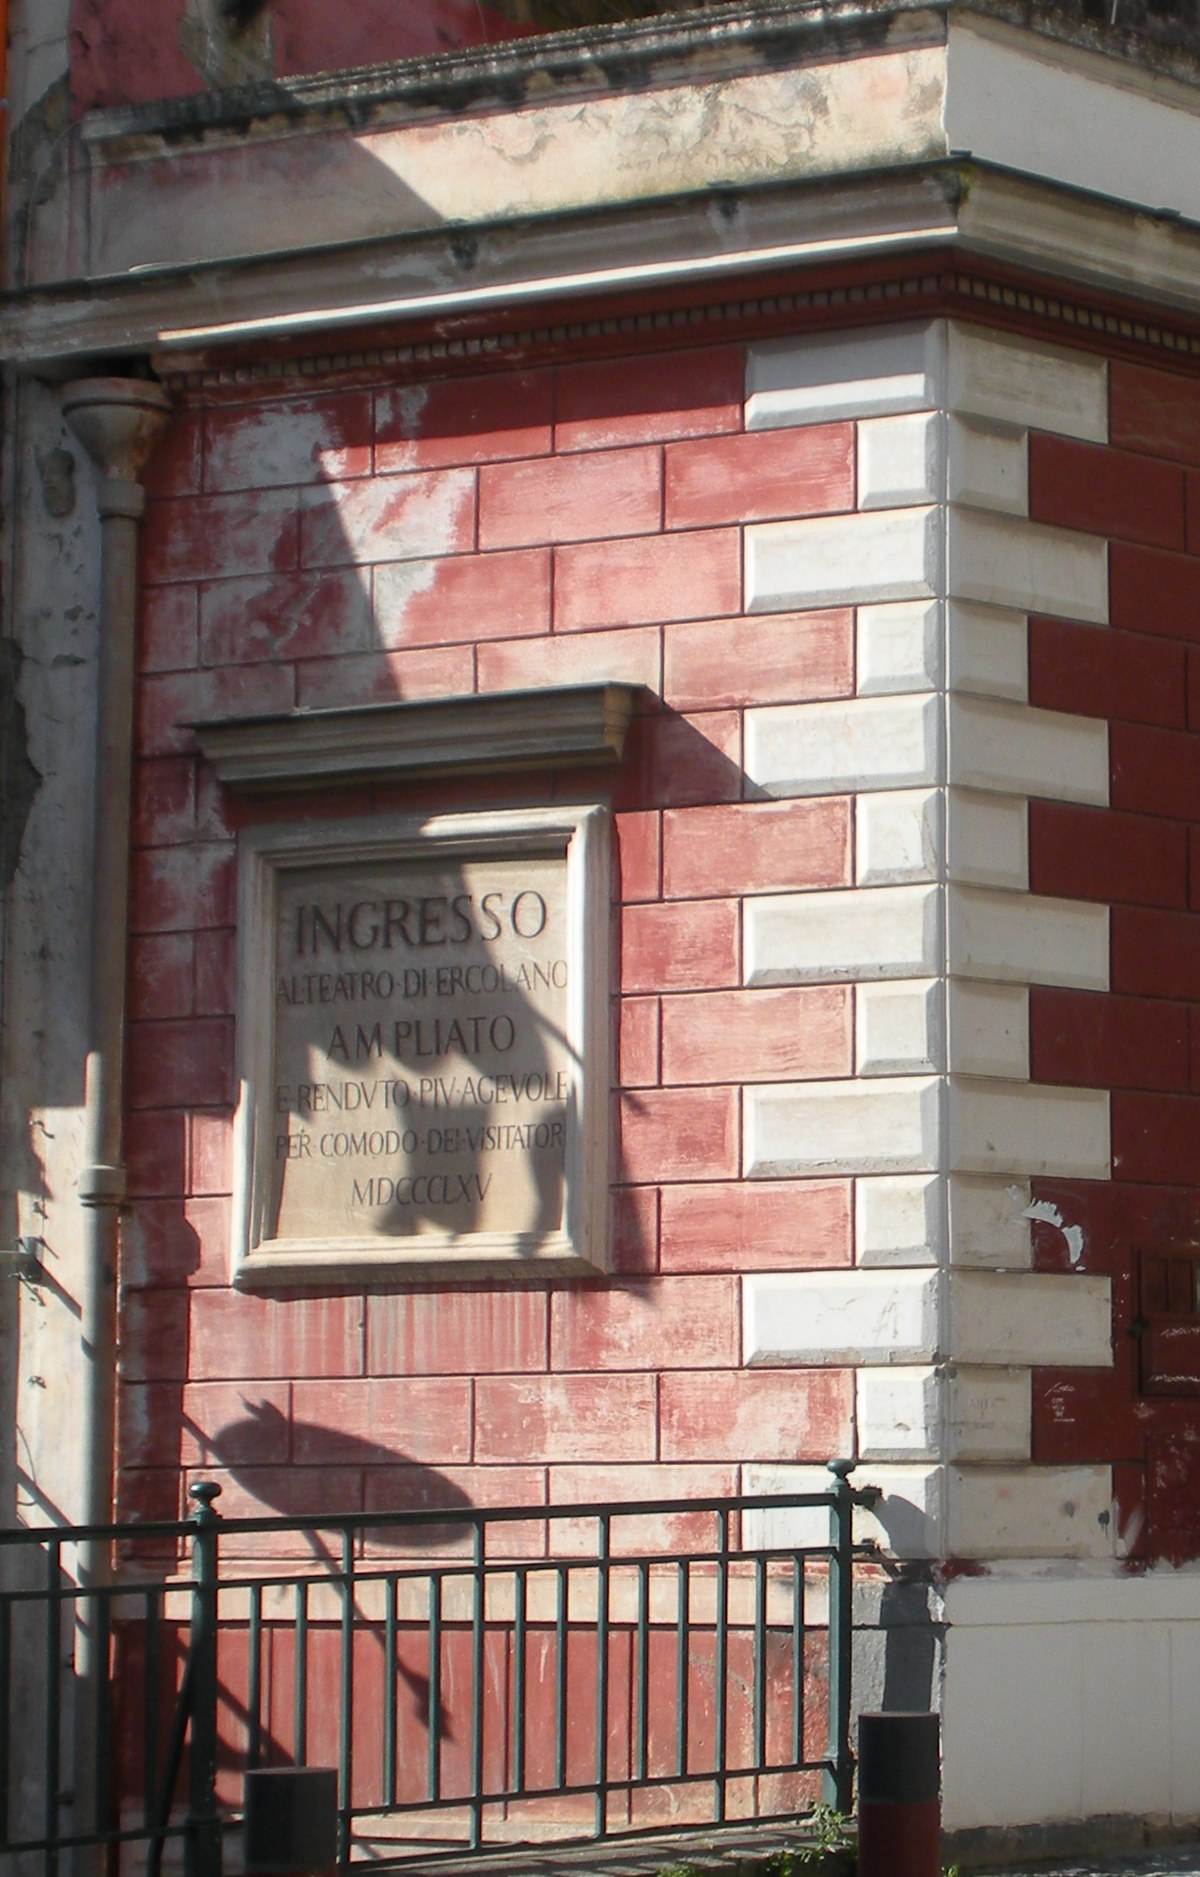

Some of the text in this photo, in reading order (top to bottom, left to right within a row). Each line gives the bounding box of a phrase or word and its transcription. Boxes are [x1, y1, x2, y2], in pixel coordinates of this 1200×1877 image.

[296, 890, 547, 956] INGRESSO
[303, 969, 394, 1004] TEATRO
[403, 966, 428, 999] DI
[436, 958, 568, 996] ERCOLANO
[326, 1014, 516, 1062] AMPLIATO
[461, 1069, 568, 1106] AGEVOLE
[319, 1129, 418, 1158] COMODO
[351, 1172, 493, 1208] MDCCCLXV
